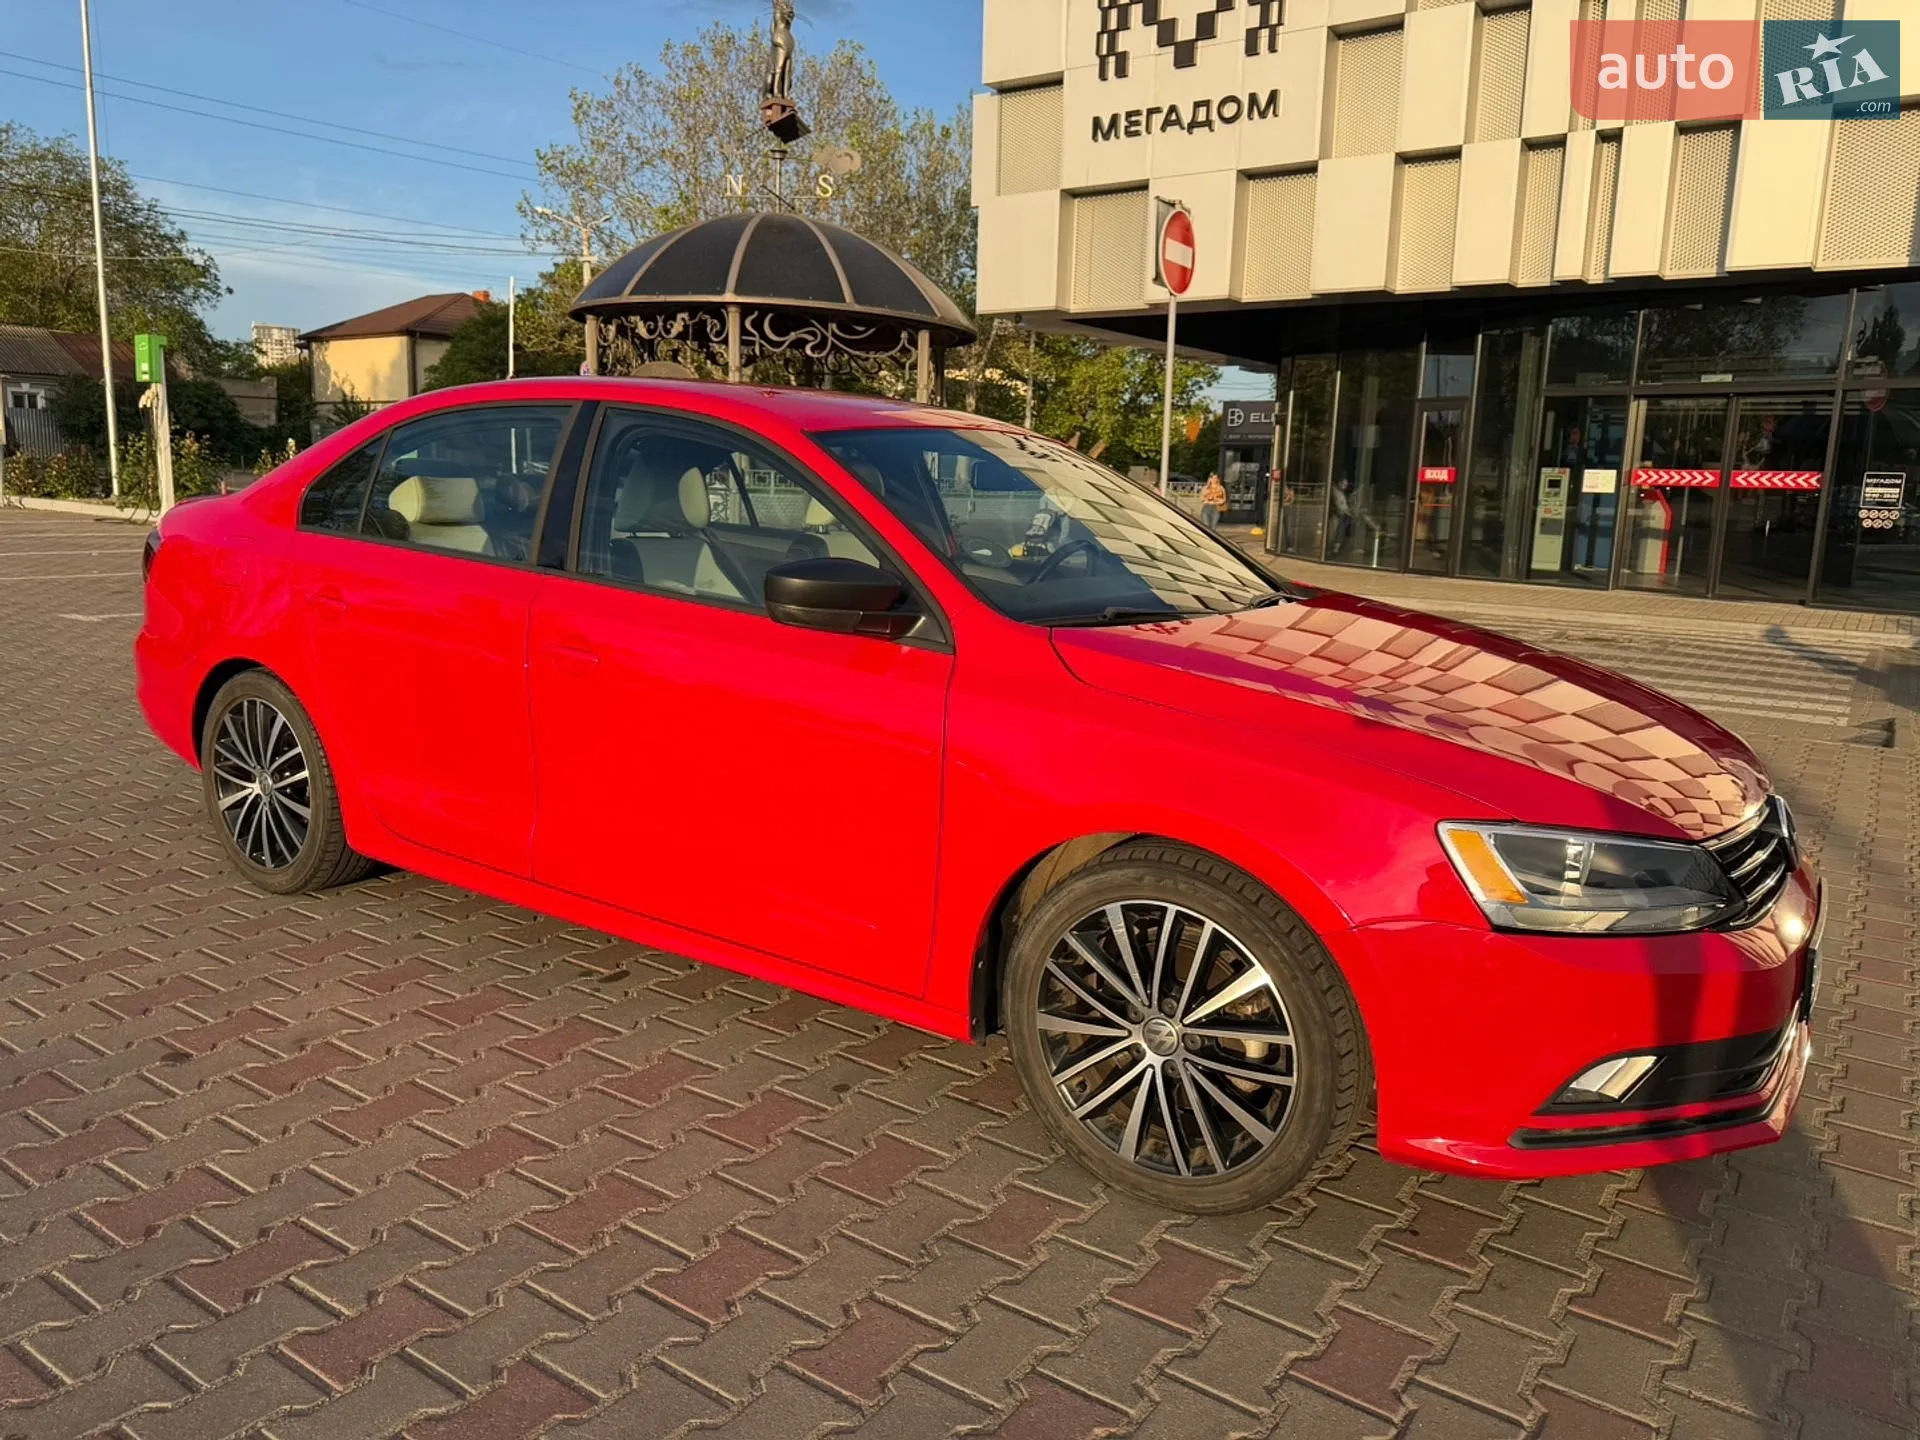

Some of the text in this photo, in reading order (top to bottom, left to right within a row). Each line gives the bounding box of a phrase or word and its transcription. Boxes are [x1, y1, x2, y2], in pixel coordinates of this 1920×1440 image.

[1091, 89, 1281, 143] МЕГАДОМ
[725, 174, 743, 197] N
[816, 174, 834, 197] S
